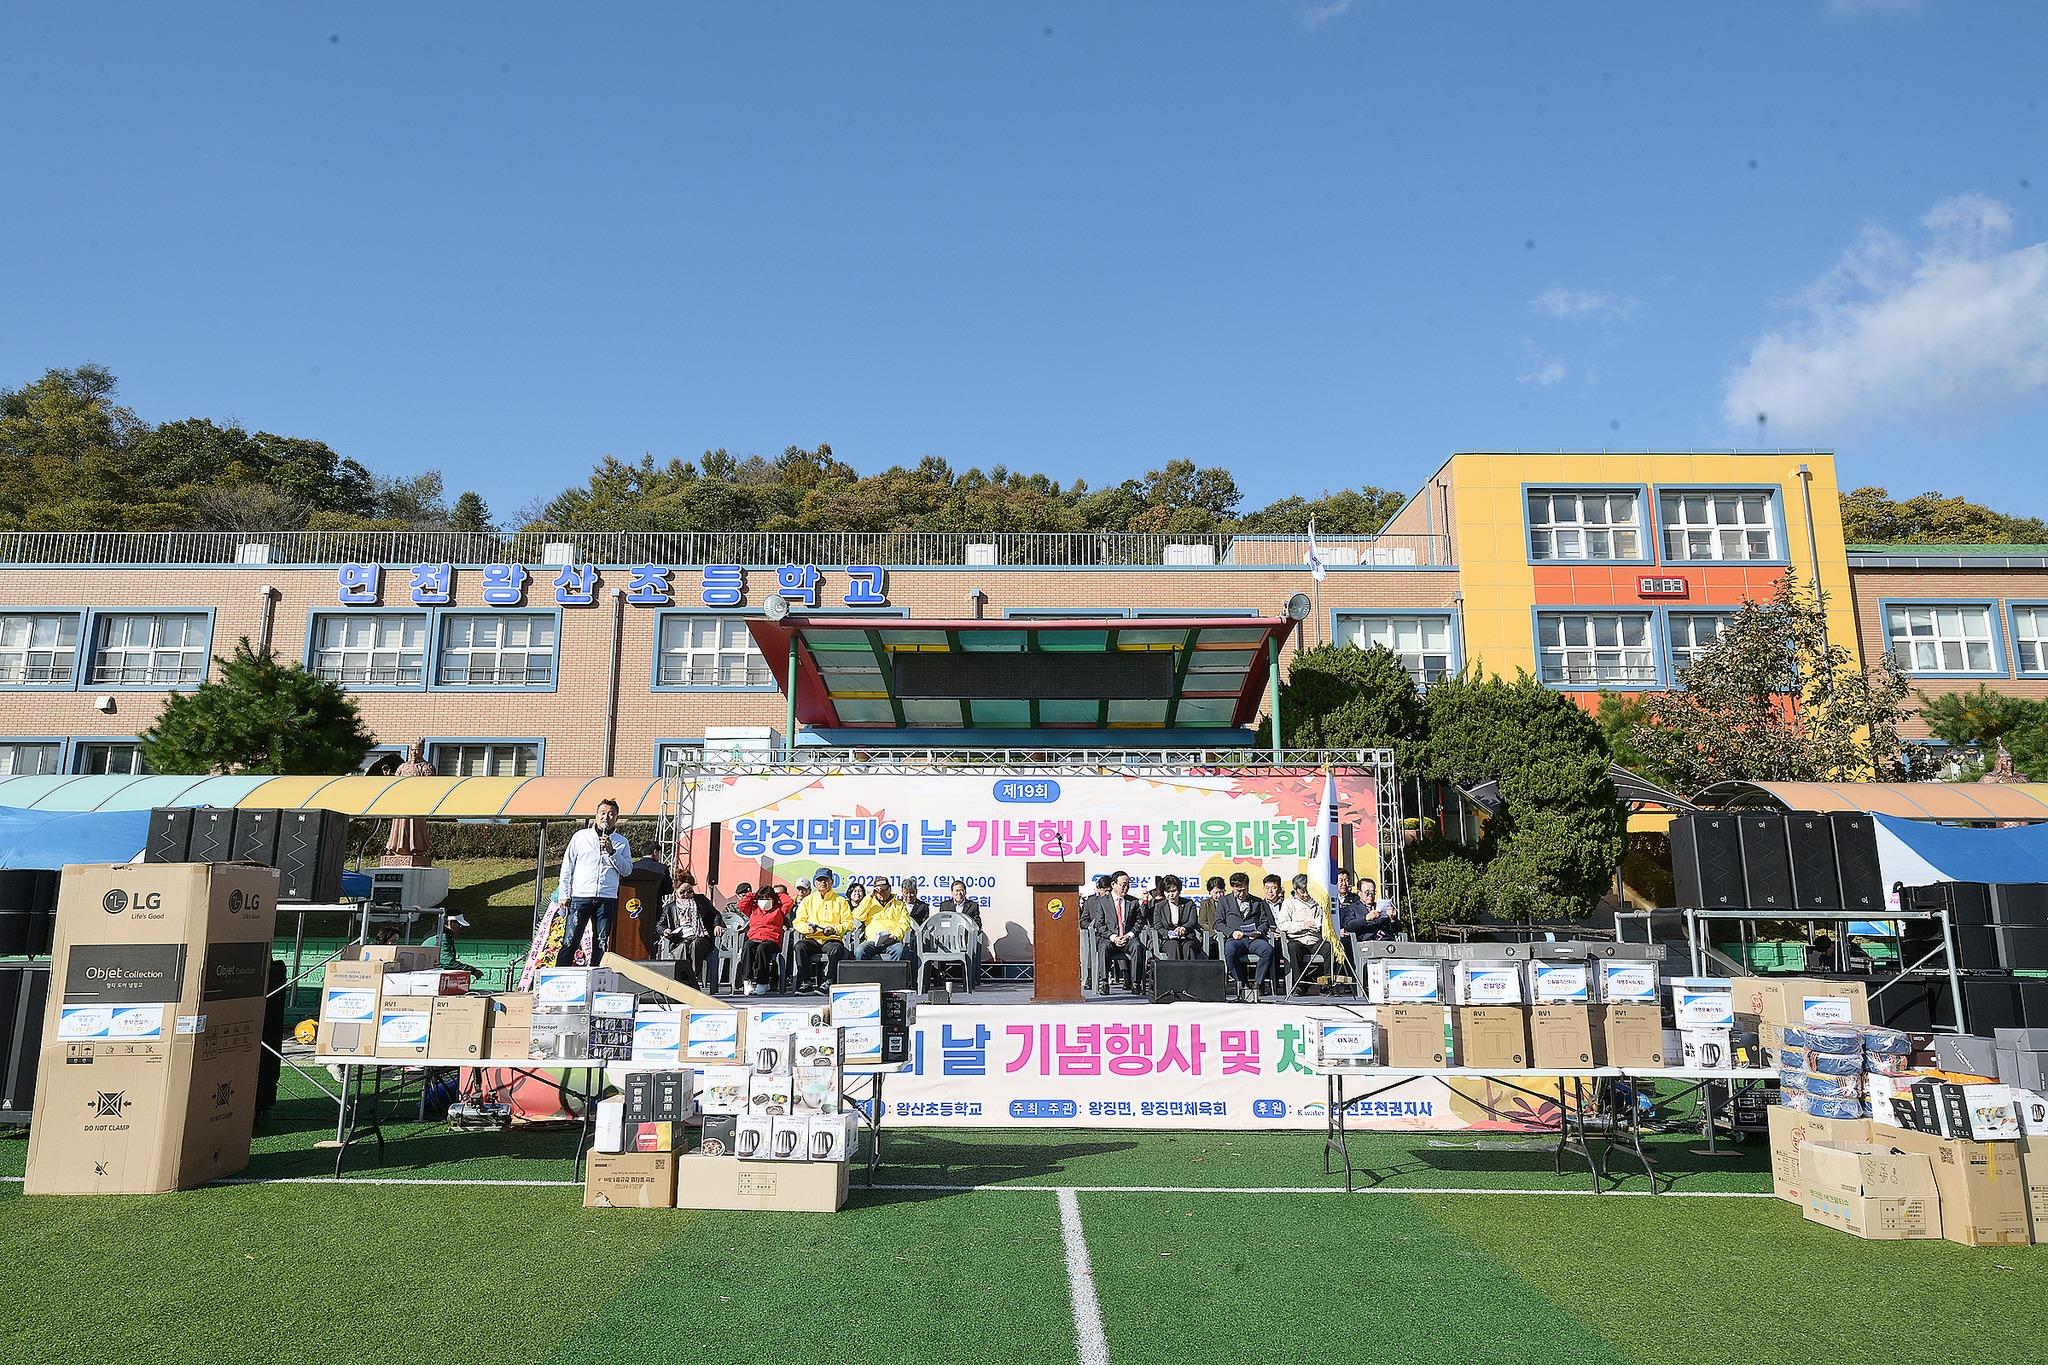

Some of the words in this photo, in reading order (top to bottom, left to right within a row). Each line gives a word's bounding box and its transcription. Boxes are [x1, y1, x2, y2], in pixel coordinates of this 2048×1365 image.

[336, 561, 886, 607] 연천왕산초등학교
[1002, 783, 1049, 800] 제19회
[734, 818, 909, 857] 왕징면민의
[920, 819, 957, 857] 날
[966, 818, 1111, 858] 기념행사
[1121, 824, 1151, 856] 및
[1161, 818, 1306, 859] 체육대회
[132, 892, 161, 910] LG
[244, 893, 260, 911] LG
[131, 912, 147, 920] Life's
[147, 912, 165, 920] Good
[85, 965, 122, 982] Objet
[123, 969, 164, 979] Collection
[941, 1023, 992, 1077] 날
[1005, 1023, 1206, 1077] 기념행사
[1220, 1029, 1262, 1077] 및
[896, 1101, 983, 1117] 왕산초등학교
[1088, 1101, 1136, 1118] 왕징면,
[1140, 1101, 1227, 1117] 왕징면체육회
[84, 1124, 94, 1132] DO
[95, 1124, 107, 1132] NOT
[108, 1123, 130, 1131] CLAMP
